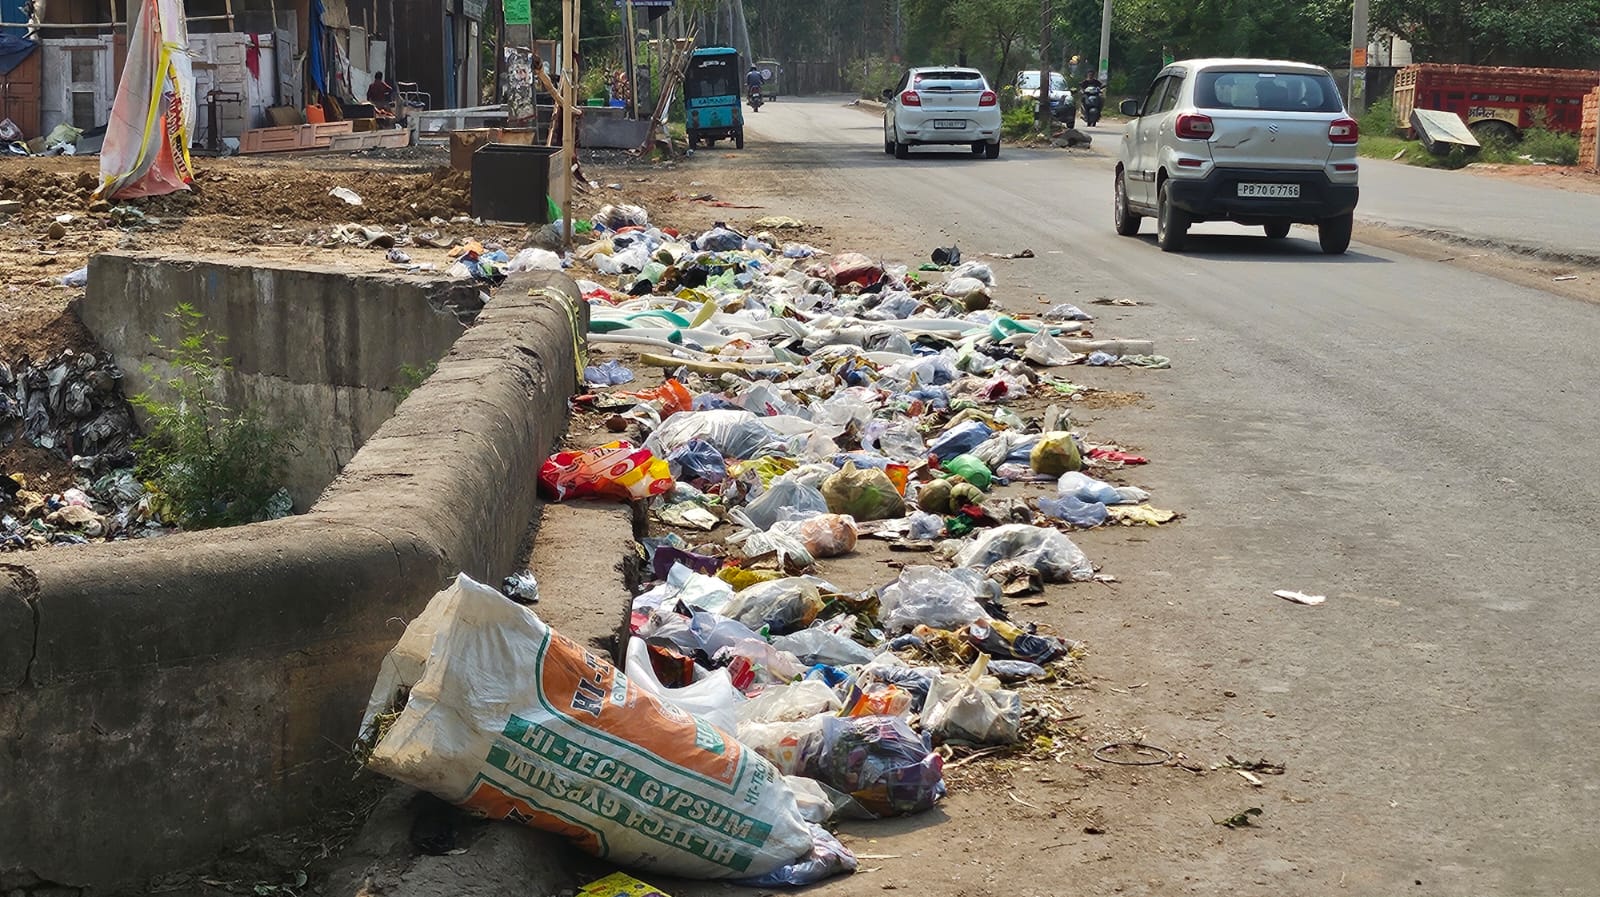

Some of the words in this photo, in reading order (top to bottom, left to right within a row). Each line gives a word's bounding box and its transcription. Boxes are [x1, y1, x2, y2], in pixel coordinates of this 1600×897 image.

[504, 752, 622, 818] GYPSUM
[522, 724, 636, 789] HI-TECH
[640, 779, 754, 839] GYPSUM
[625, 806, 736, 865] HI-TECH
